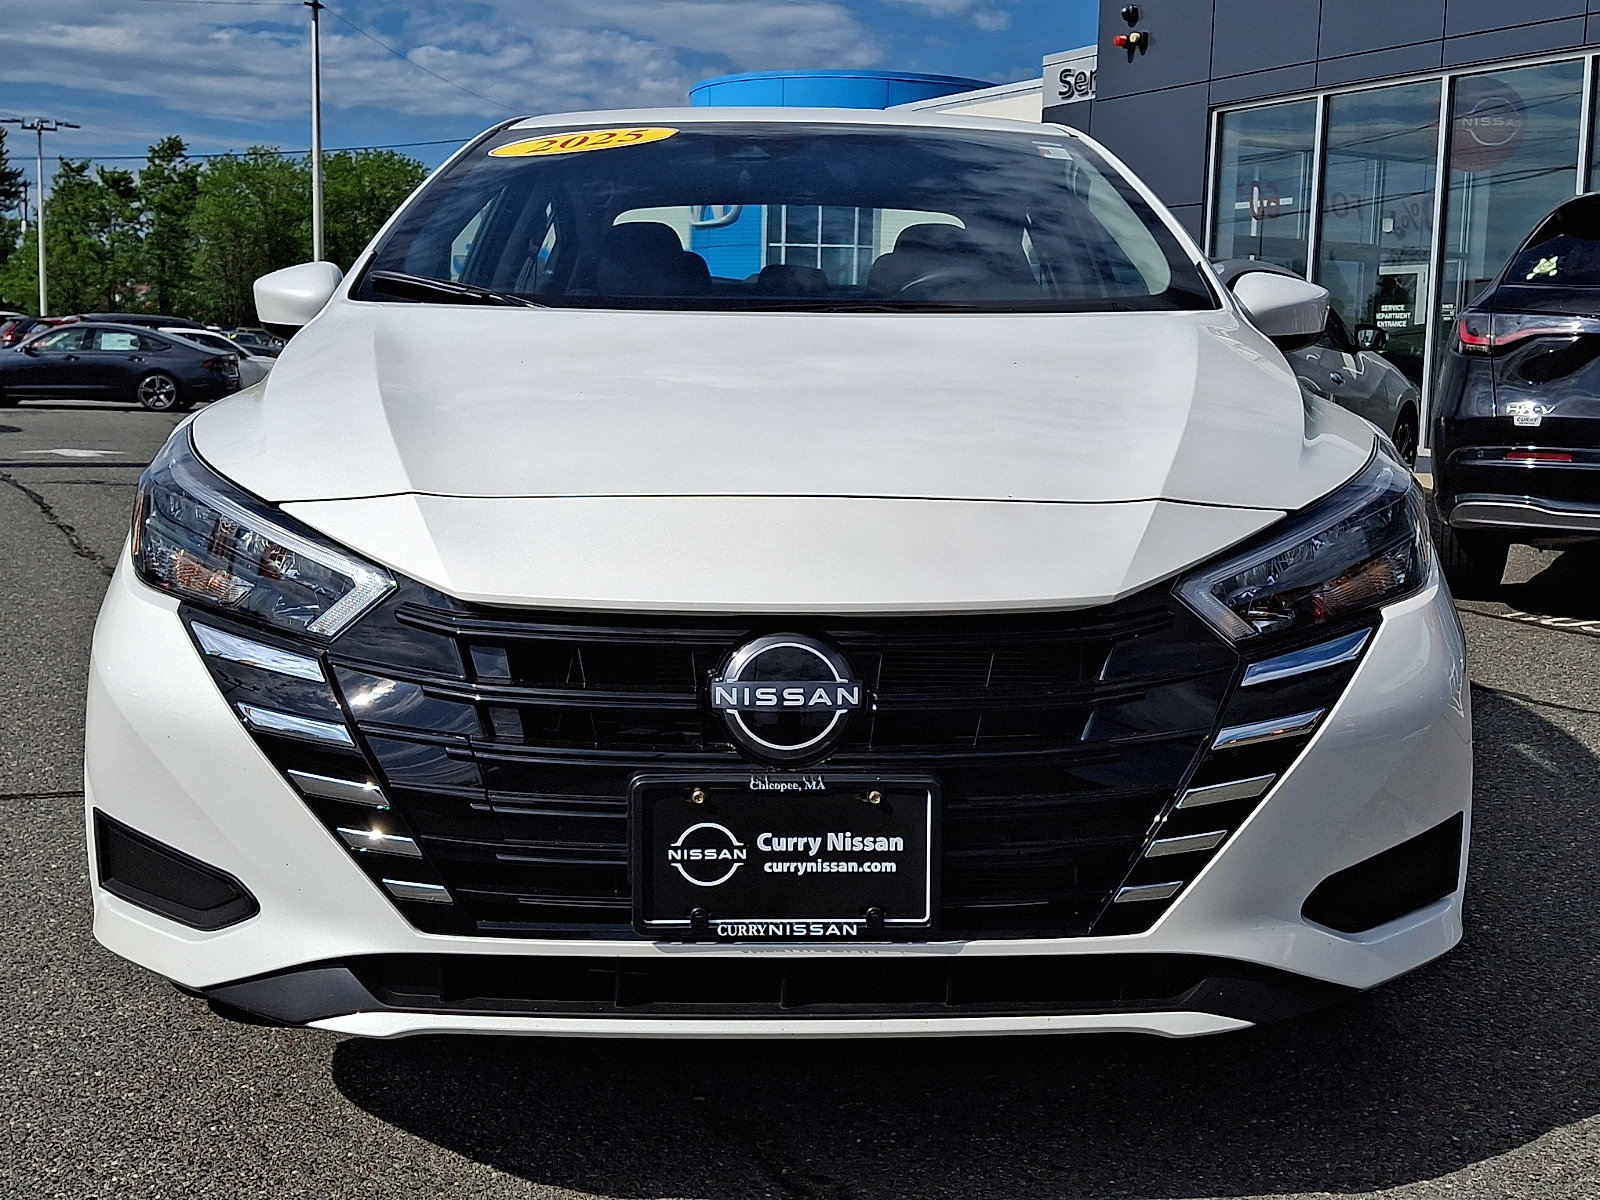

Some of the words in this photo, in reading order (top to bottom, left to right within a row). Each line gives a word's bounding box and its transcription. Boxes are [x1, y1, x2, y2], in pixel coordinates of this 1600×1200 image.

[525, 129, 650, 154] 2025
[715, 687, 859, 706] NISSAN
[749, 780, 802, 792] Chicopee,
[804, 780, 826, 790] MA
[756, 832, 822, 856] Curry
[826, 832, 904, 852] Nissan
[667, 848, 747, 860] NISSAN
[763, 859, 897, 875] currynissan.com
